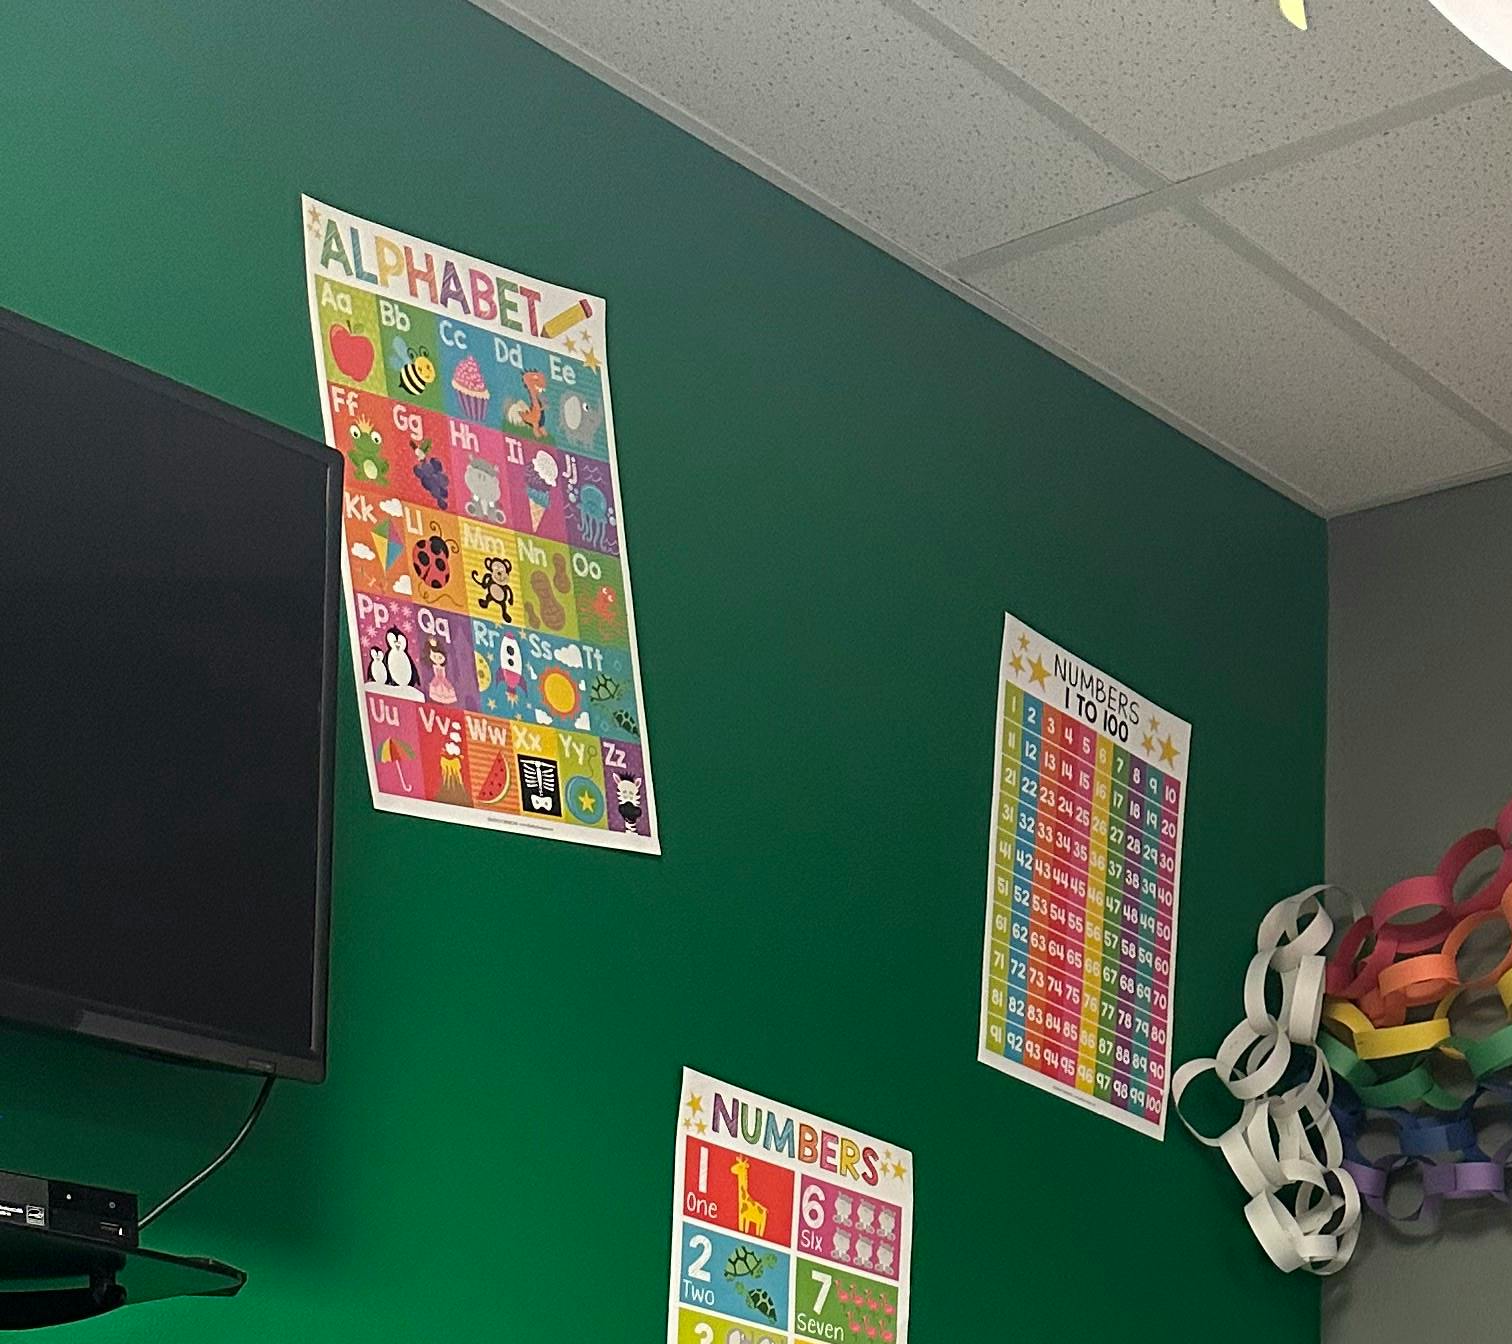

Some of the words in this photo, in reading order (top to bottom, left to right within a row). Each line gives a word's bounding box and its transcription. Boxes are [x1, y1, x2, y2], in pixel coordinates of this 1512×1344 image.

[320, 218, 541, 338] ALPHABET
[321, 283, 352, 315] Aa
[379, 300, 411, 332] Bb
[439, 320, 468, 350] Cc
[494, 337, 523, 368] Dd
[550, 356, 576, 385] Ee
[331, 387, 359, 417] Ff
[392, 405, 423, 440] Gg
[450, 421, 479, 452] Hh
[505, 438, 524, 465] Ii
[562, 454, 578, 484] Jj
[344, 493, 377, 523] Kk
[404, 509, 424, 536] Ll
[463, 526, 506, 554] Mm
[517, 540, 547, 566] Nn
[572, 553, 601, 579] Oo
[357, 594, 389, 627] Pp
[417, 608, 450, 643] Qq
[475, 621, 500, 648] Rr
[529, 634, 552, 660] Ss
[582, 647, 603, 671] Tt
[1054, 654, 1140, 725] NUMBERS
[369, 697, 399, 726] Uu
[418, 707, 450, 736] Vv
[1065, 687, 1069, 709] 1
[1077, 694, 1097, 723] TO
[1104, 710, 1128, 742] 100
[467, 717, 507, 745] Ww
[512, 726, 542, 751] Xx
[560, 734, 586, 765] Yy
[603, 742, 627, 768] Zz
[1011, 696, 1016, 712] 1
[1027, 707, 1036, 724] 2
[1048, 718, 1055, 734] 3
[1064, 728, 1073, 744] 4
[1083, 737, 1090, 754] 5
[1100, 749, 1106, 764] 6
[1116, 758, 1123, 773] 7
[1133, 768, 1140, 784] 8
[1149, 777, 1157, 794] 9
[1166, 785, 1176, 804] 10
[1005, 769, 1016, 786] 21
[1022, 777, 1037, 797] 22
[1040, 787, 1055, 807] 23
[1058, 797, 1073, 816] 24
[1076, 806, 1089, 826] 25
[1093, 816, 1107, 833] 26
[1110, 826, 1124, 844] 27
[1127, 835, 1140, 854] 28
[1143, 845, 1158, 864] 29
[1160, 854, 1173, 872] 30
[997, 877, 1008, 896] 51
[1014, 886, 1029, 906] 52
[1032, 894, 1048, 915] 53
[1050, 904, 1065, 925] 54
[1067, 914, 1083, 932] 55
[1086, 921, 1100, 940] 56
[1104, 931, 1118, 951] 57
[1121, 939, 1136, 958] 58
[1138, 946, 1152, 968] 59
[1155, 954, 1168, 975] 60
[993, 951, 1004, 969] 71
[1011, 959, 1025, 979] 72
[1029, 968, 1044, 987] 73
[1048, 976, 1062, 996] 74
[1066, 984, 1080, 1004] 75
[1084, 994, 1098, 1012] 76
[1101, 1001, 1115, 1020] 77
[1118, 1010, 1132, 1028] 78
[1135, 1018, 1149, 1037] 79
[1151, 1027, 1166, 1044] 80
[990, 1025, 1002, 1043] 91
[1007, 1032, 1022, 1051] 92
[1025, 1041, 1041, 1059] 93
[1043, 1049, 1058, 1068] 94
[1061, 1057, 1075, 1076] 95
[1077, 1065, 1093, 1083] 96
[1097, 1073, 1111, 1091] 97
[1113, 1080, 1128, 1099] 98
[1130, 1089, 1144, 1107] 99
[1146, 1092, 1160, 1114] 100
[711, 1093, 879, 1186] NUMBERS
[699, 1147, 709, 1193] 1
[686, 1192, 717, 1218] One
[801, 1184, 826, 1230] 6
[688, 1234, 713, 1282] 2
[683, 1279, 715, 1305] Two
[811, 1270, 832, 1314] 7
[797, 1314, 844, 1341] Seven
